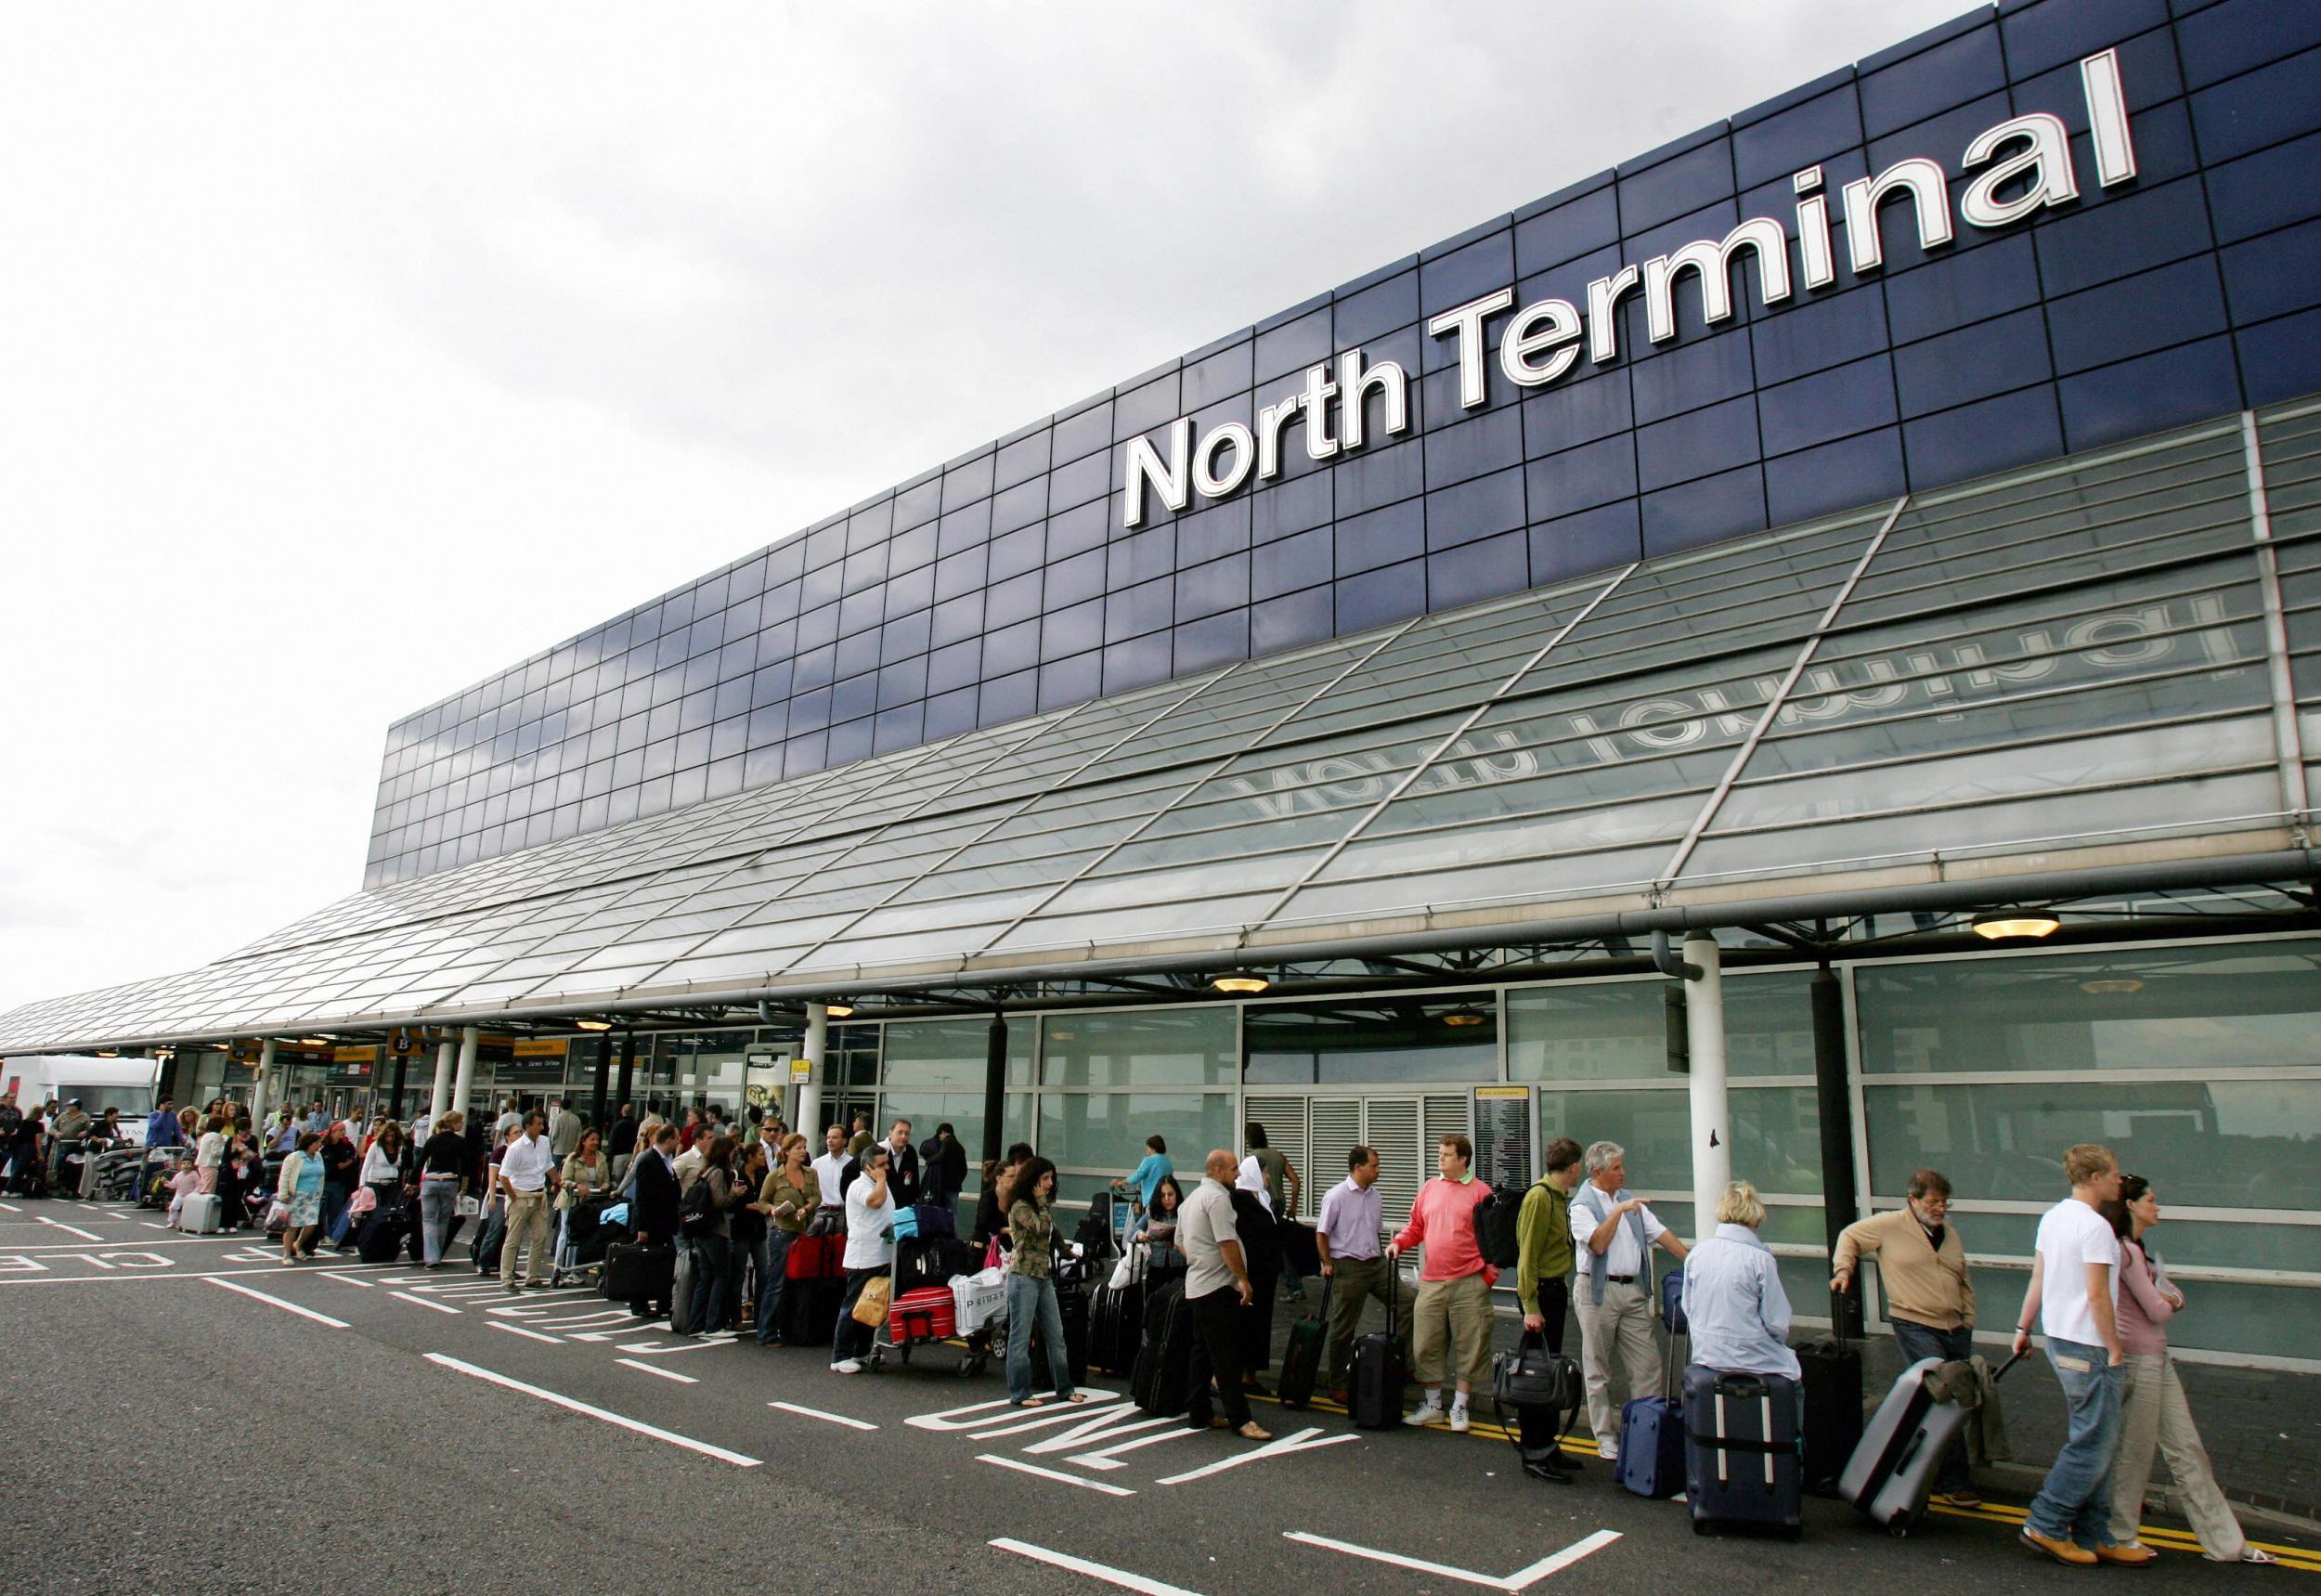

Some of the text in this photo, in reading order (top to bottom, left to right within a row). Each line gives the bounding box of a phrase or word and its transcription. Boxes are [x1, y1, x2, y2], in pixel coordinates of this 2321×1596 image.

[1122, 45, 2137, 530] North Terminal
[397, 1038, 408, 1049] B
[966, 1291, 1005, 1309] PRIMAR
[903, 1386, 1362, 1486] ONLY
